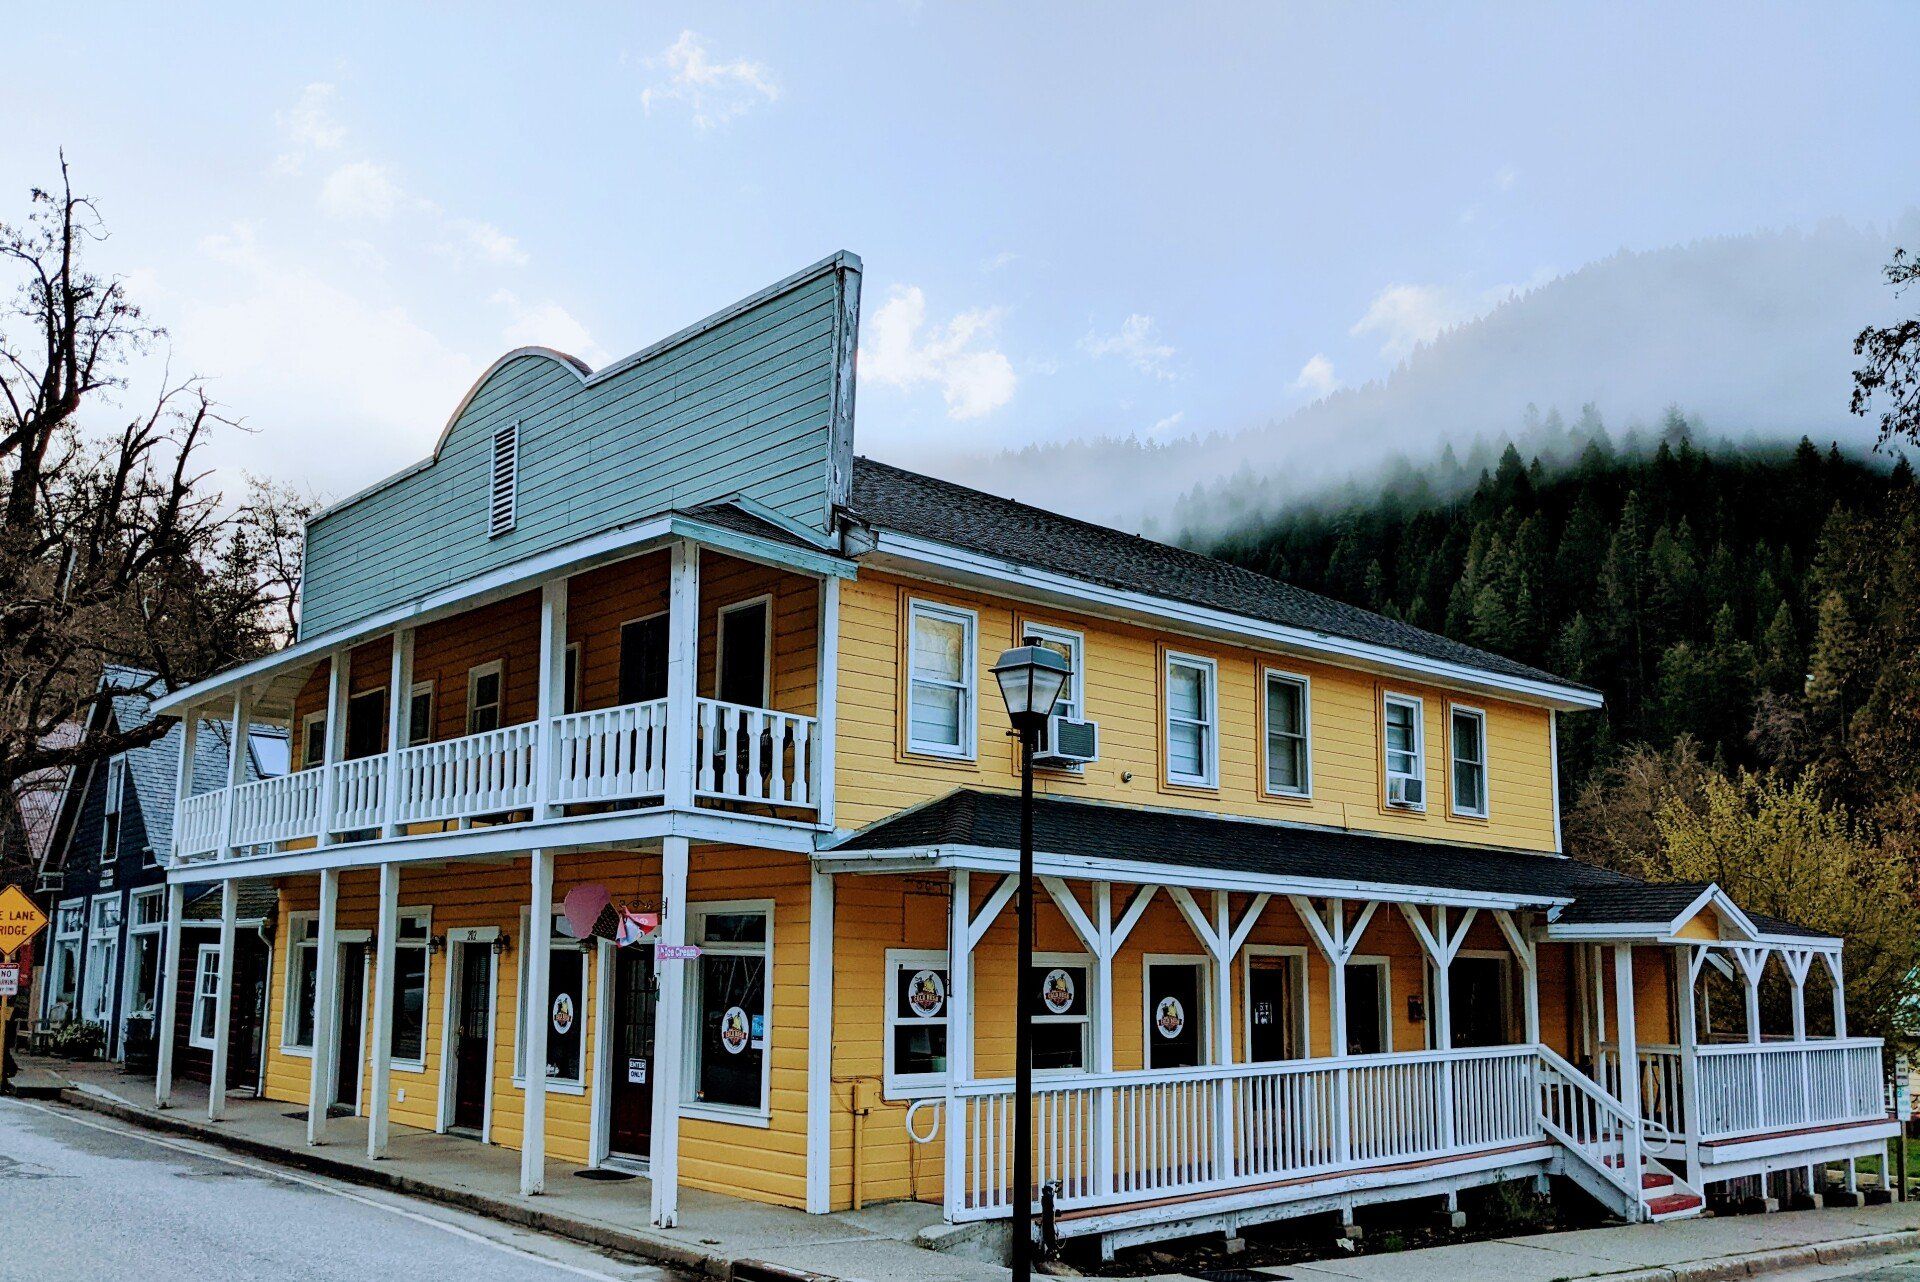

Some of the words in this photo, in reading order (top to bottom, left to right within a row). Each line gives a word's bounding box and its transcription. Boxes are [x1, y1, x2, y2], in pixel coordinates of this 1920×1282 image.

[9, 910, 35, 921] LANE
[0, 925, 27, 936] RIDGE
[675, 947, 696, 956] Cream
[1, 970, 12, 978] NO
